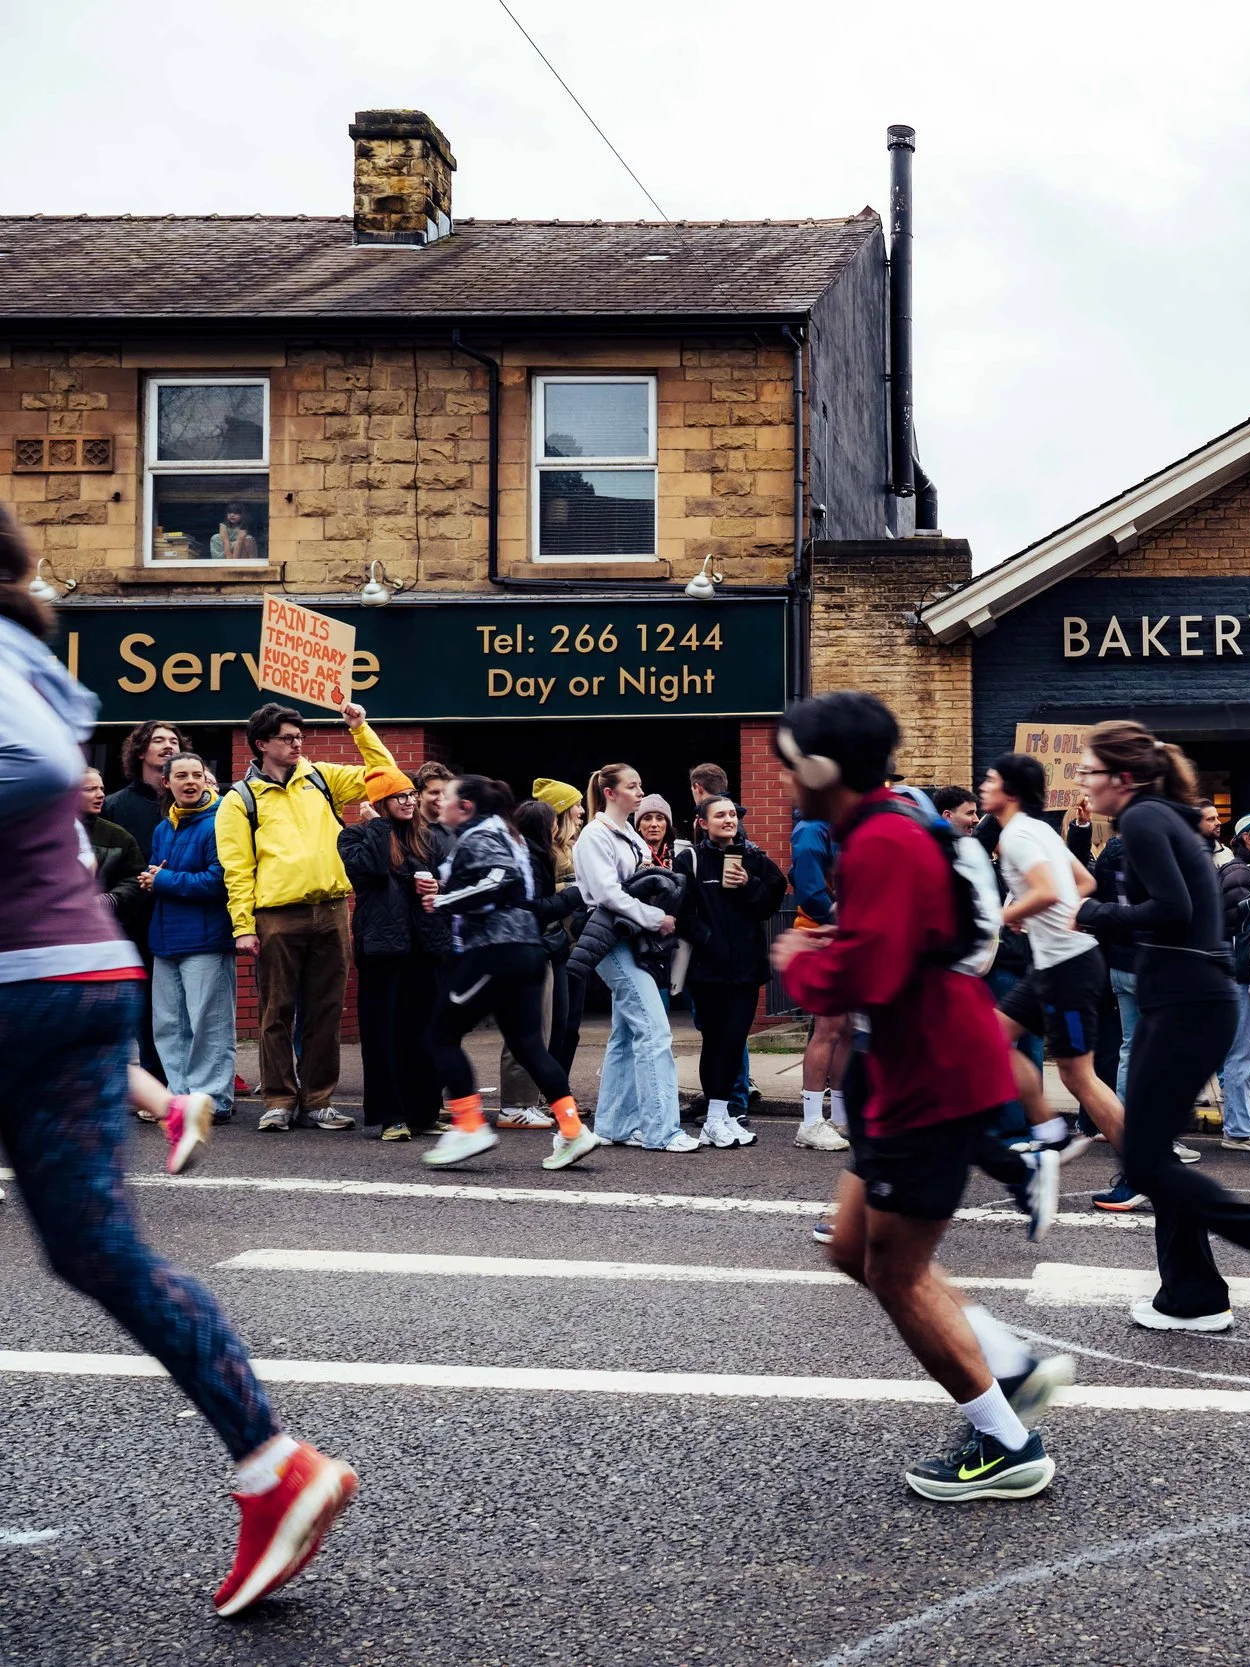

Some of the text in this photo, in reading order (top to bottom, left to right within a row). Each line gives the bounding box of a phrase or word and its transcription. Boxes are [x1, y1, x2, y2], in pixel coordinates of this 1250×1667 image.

[268, 600, 330, 641] PAIN IS
[476, 622, 723, 654] Tel: 266 1244
[264, 646, 342, 686] KUDOS ARE
[266, 626, 347, 669] TEMPORARY,
[262, 664, 326, 702] FOREVER
[488, 665, 715, 704] Day or Night
[1025, 729, 1049, 753] IT'S
